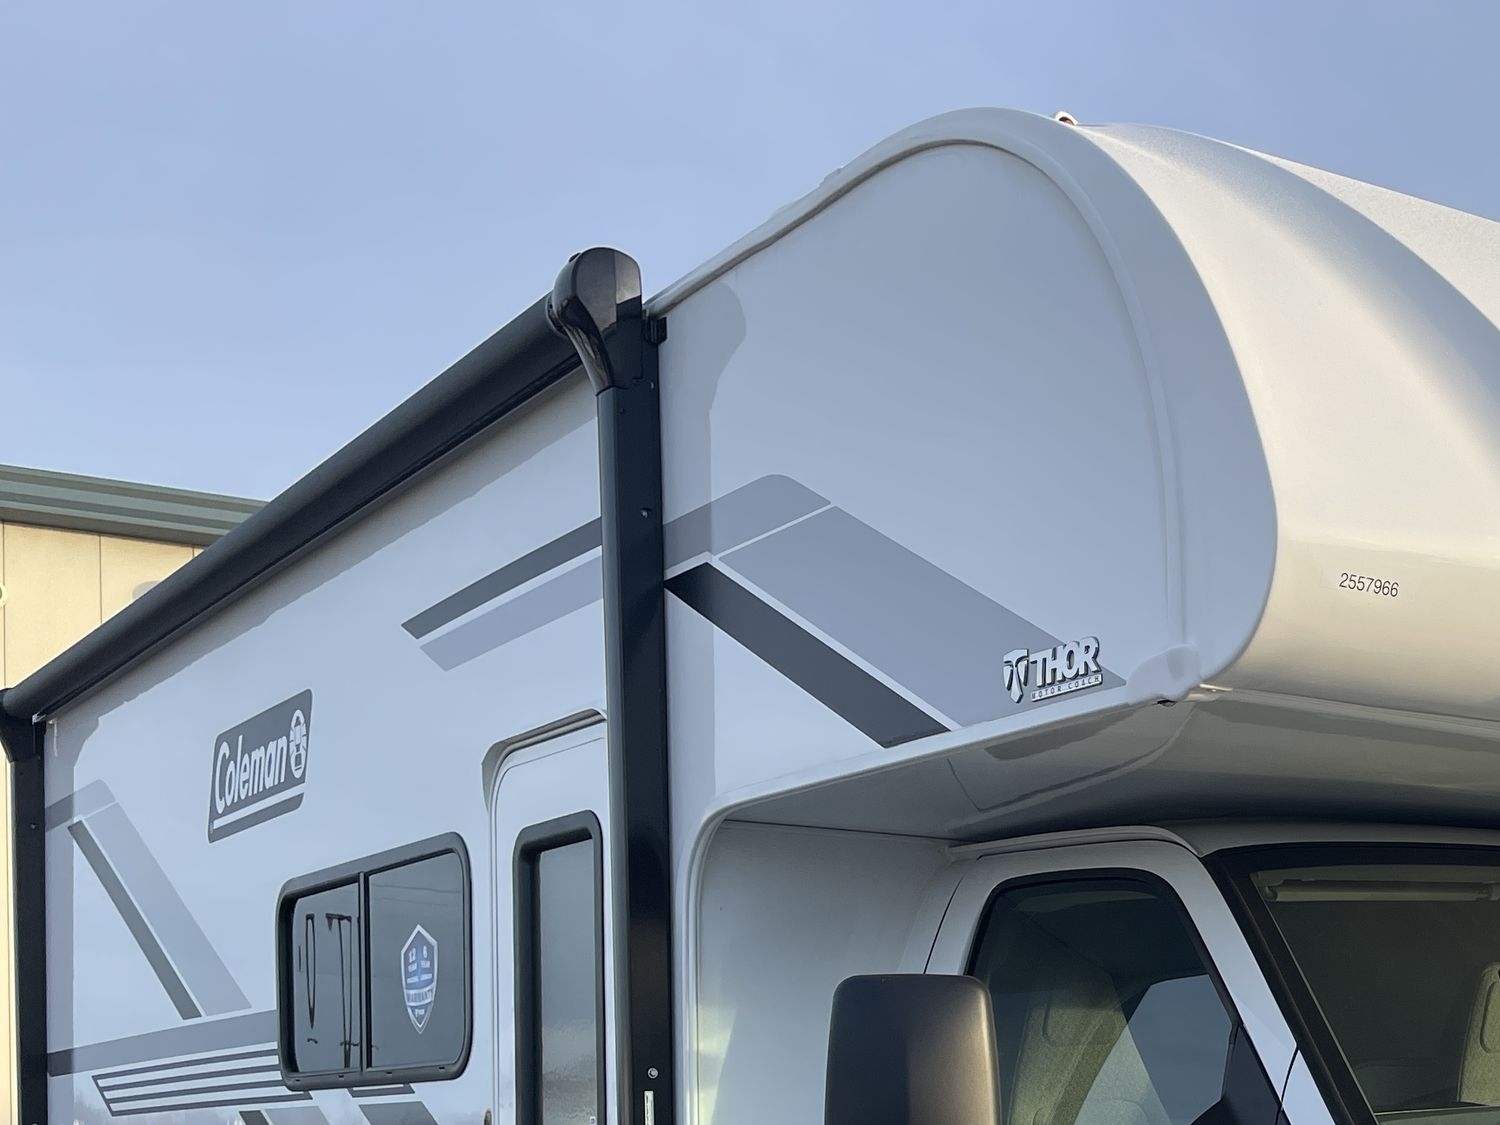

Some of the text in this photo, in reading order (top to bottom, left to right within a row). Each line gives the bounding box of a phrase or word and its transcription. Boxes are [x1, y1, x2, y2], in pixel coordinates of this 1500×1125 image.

[1339, 572, 1399, 597] 2557966
[1030, 636, 1101, 688] THOR
[1031, 675, 1100, 699] MOTOR COACH
[214, 734, 288, 815] Coleman
